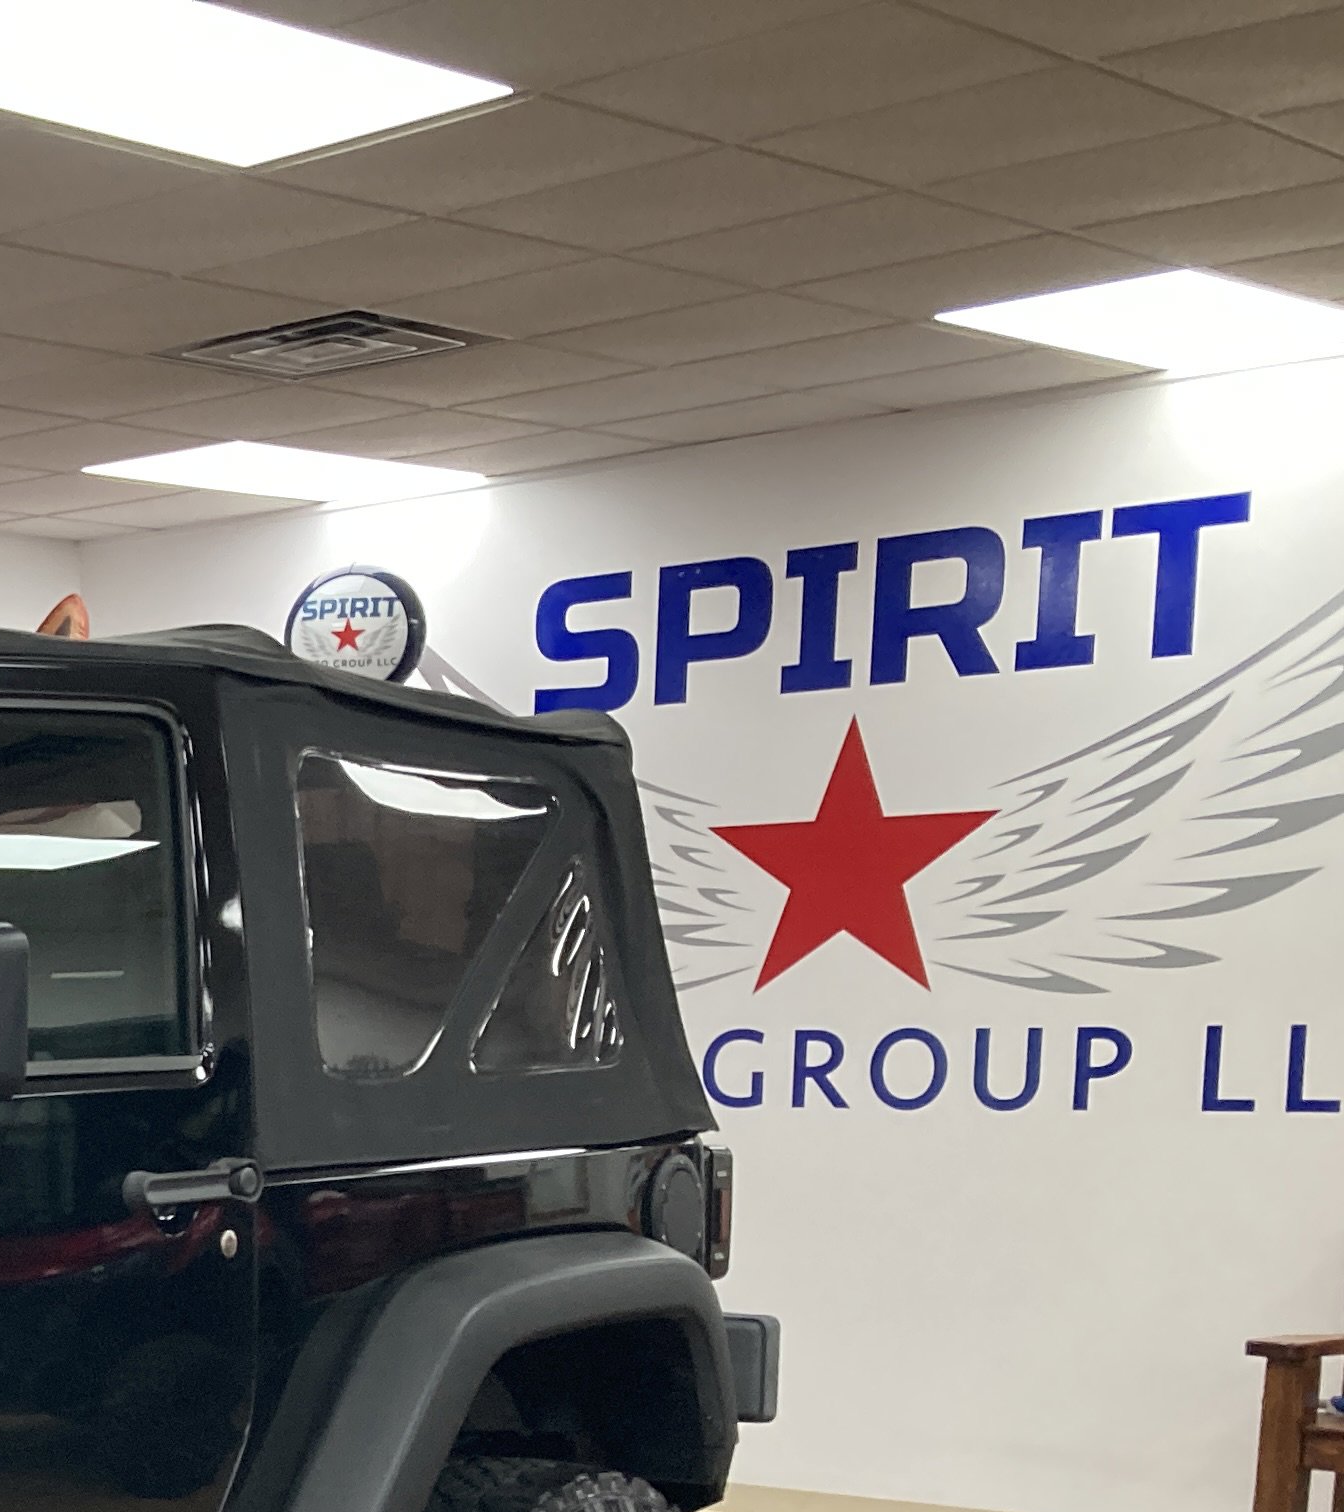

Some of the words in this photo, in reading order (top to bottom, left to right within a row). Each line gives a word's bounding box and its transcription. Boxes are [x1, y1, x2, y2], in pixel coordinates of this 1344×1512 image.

[301, 596, 398, 621] SPIRIT
[534, 490, 1253, 716] SPIRIT
[701, 1026, 1134, 1112] GROUP
